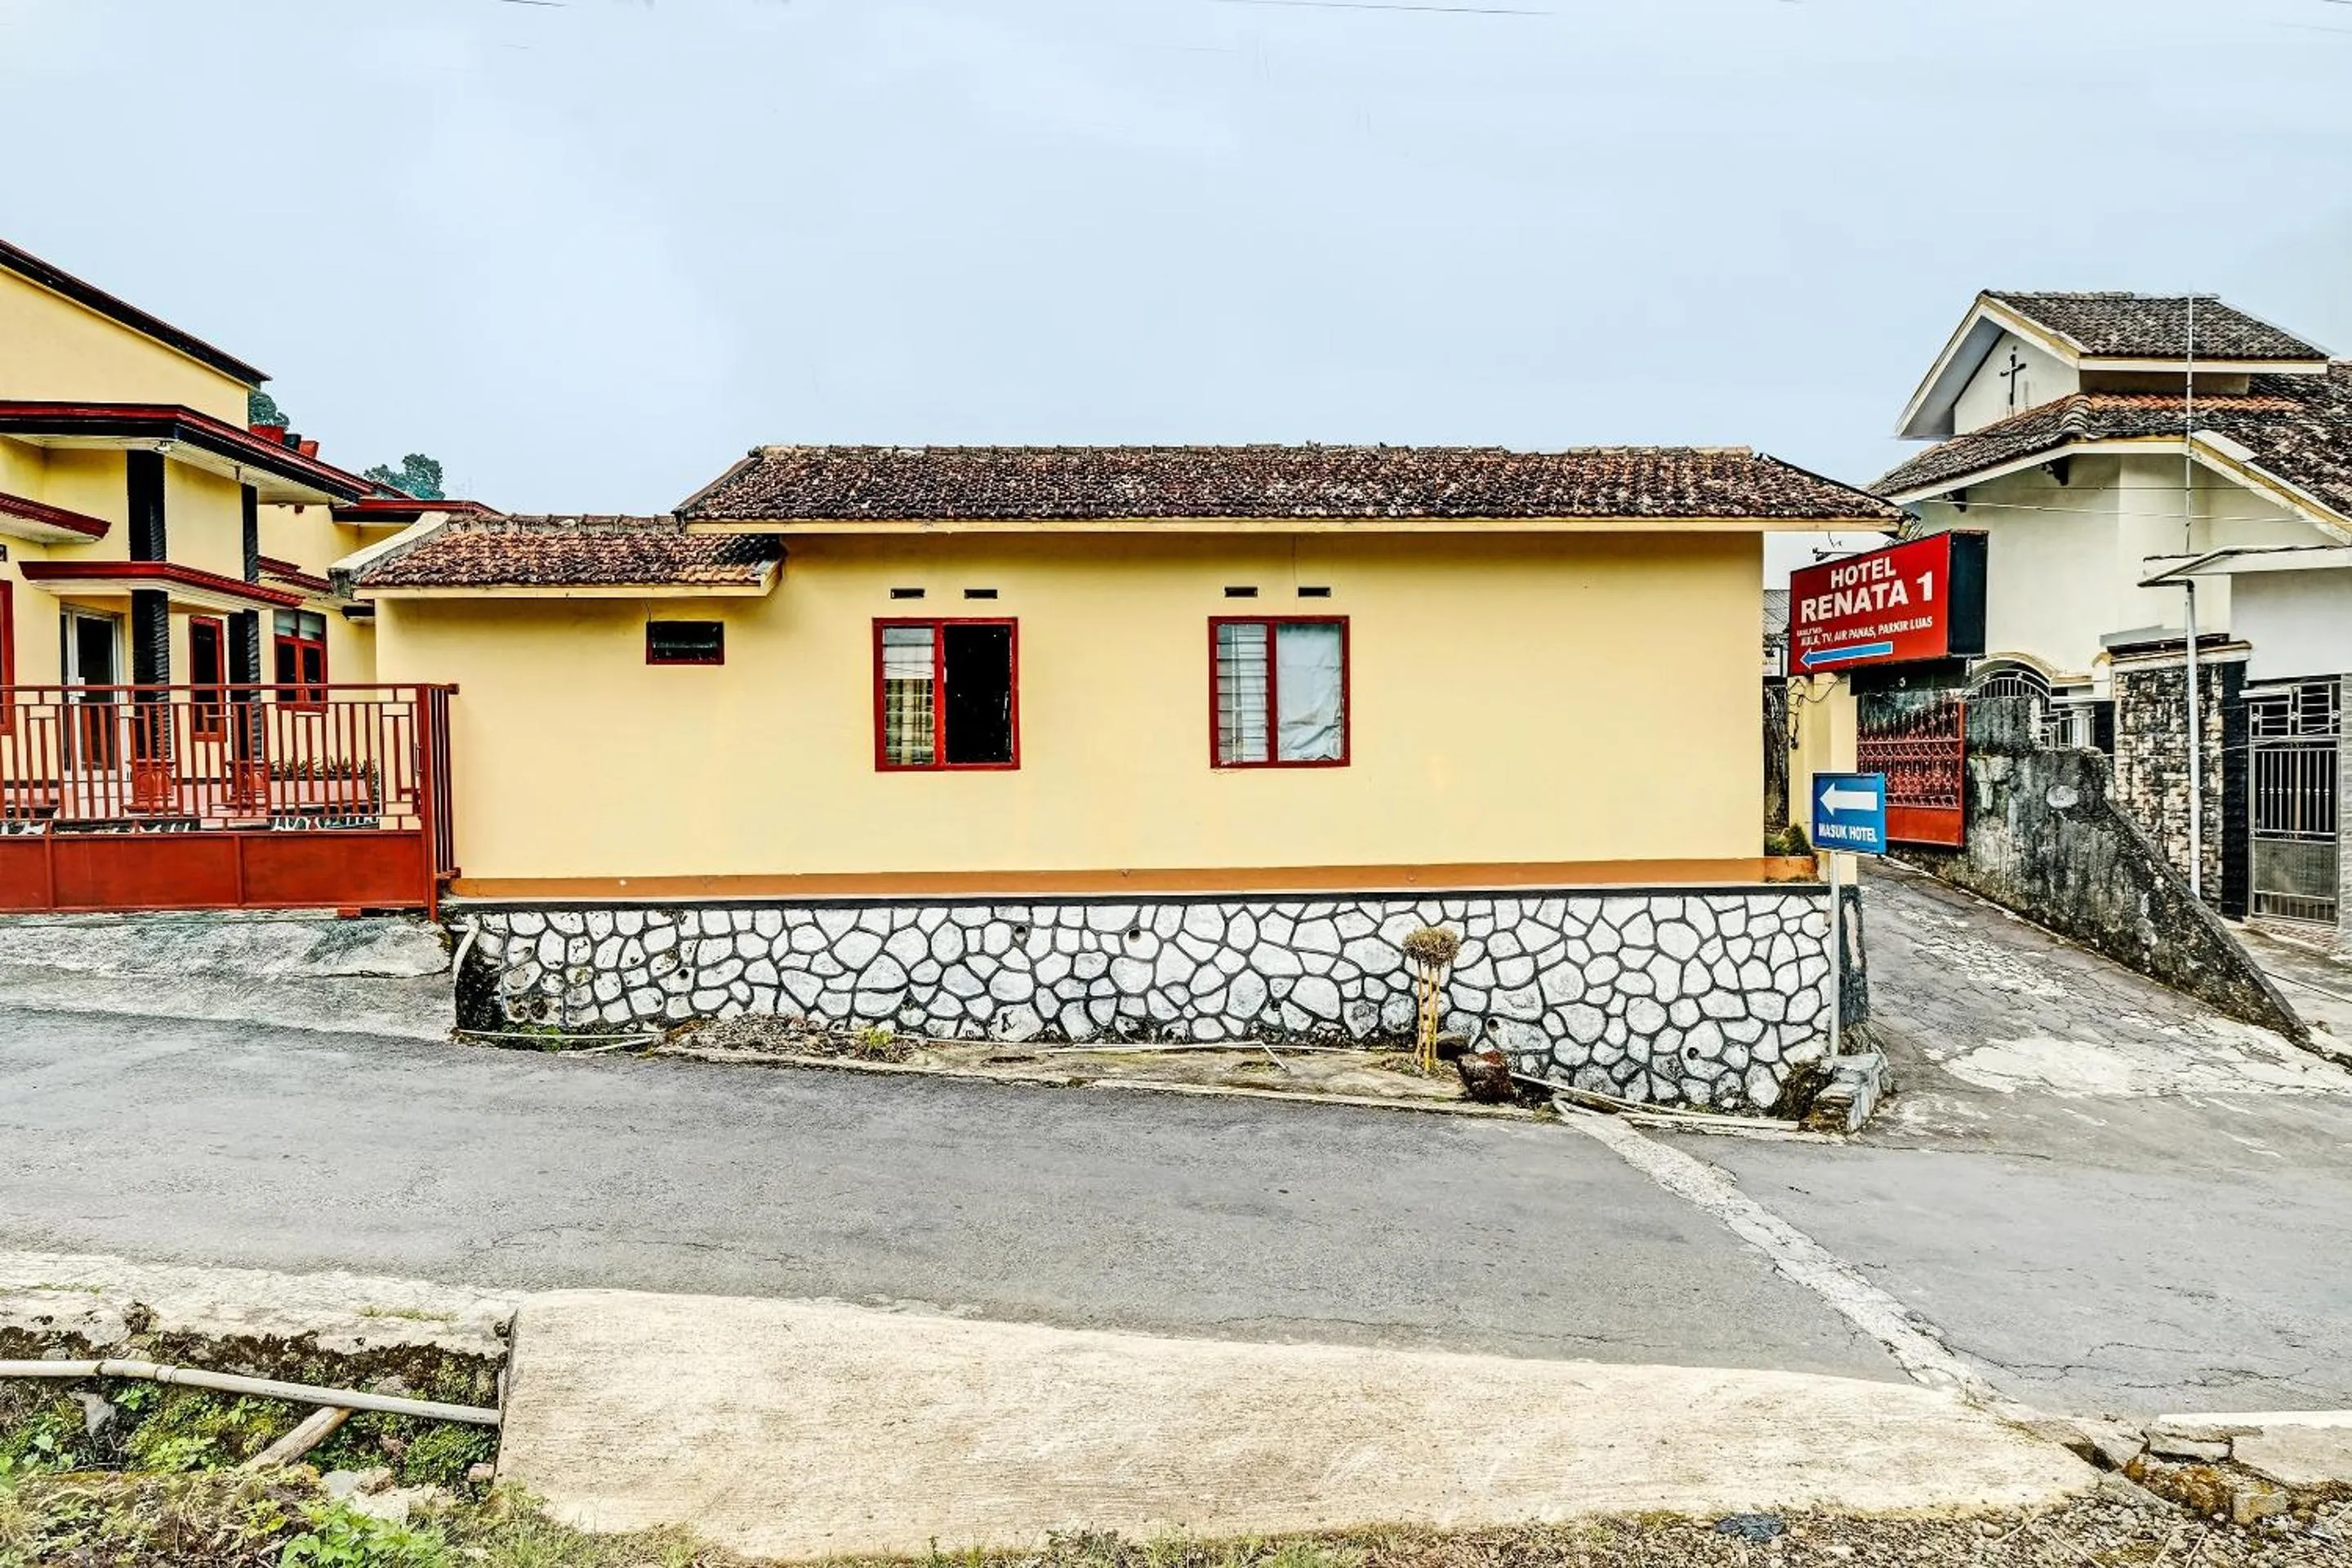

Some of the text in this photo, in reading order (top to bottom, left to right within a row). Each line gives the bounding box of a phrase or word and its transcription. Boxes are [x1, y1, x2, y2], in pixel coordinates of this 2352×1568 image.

[1831, 556, 1896, 589] HOTEL
[1801, 570, 1933, 623] RENATA 1
[1833, 629, 1848, 643] AIR
[1848, 626, 1876, 639] PANAS,
[1878, 620, 1909, 635] PARKIR
[1909, 615, 1933, 630] LUAS
[1818, 822, 1878, 843] MASUK HOTEL
